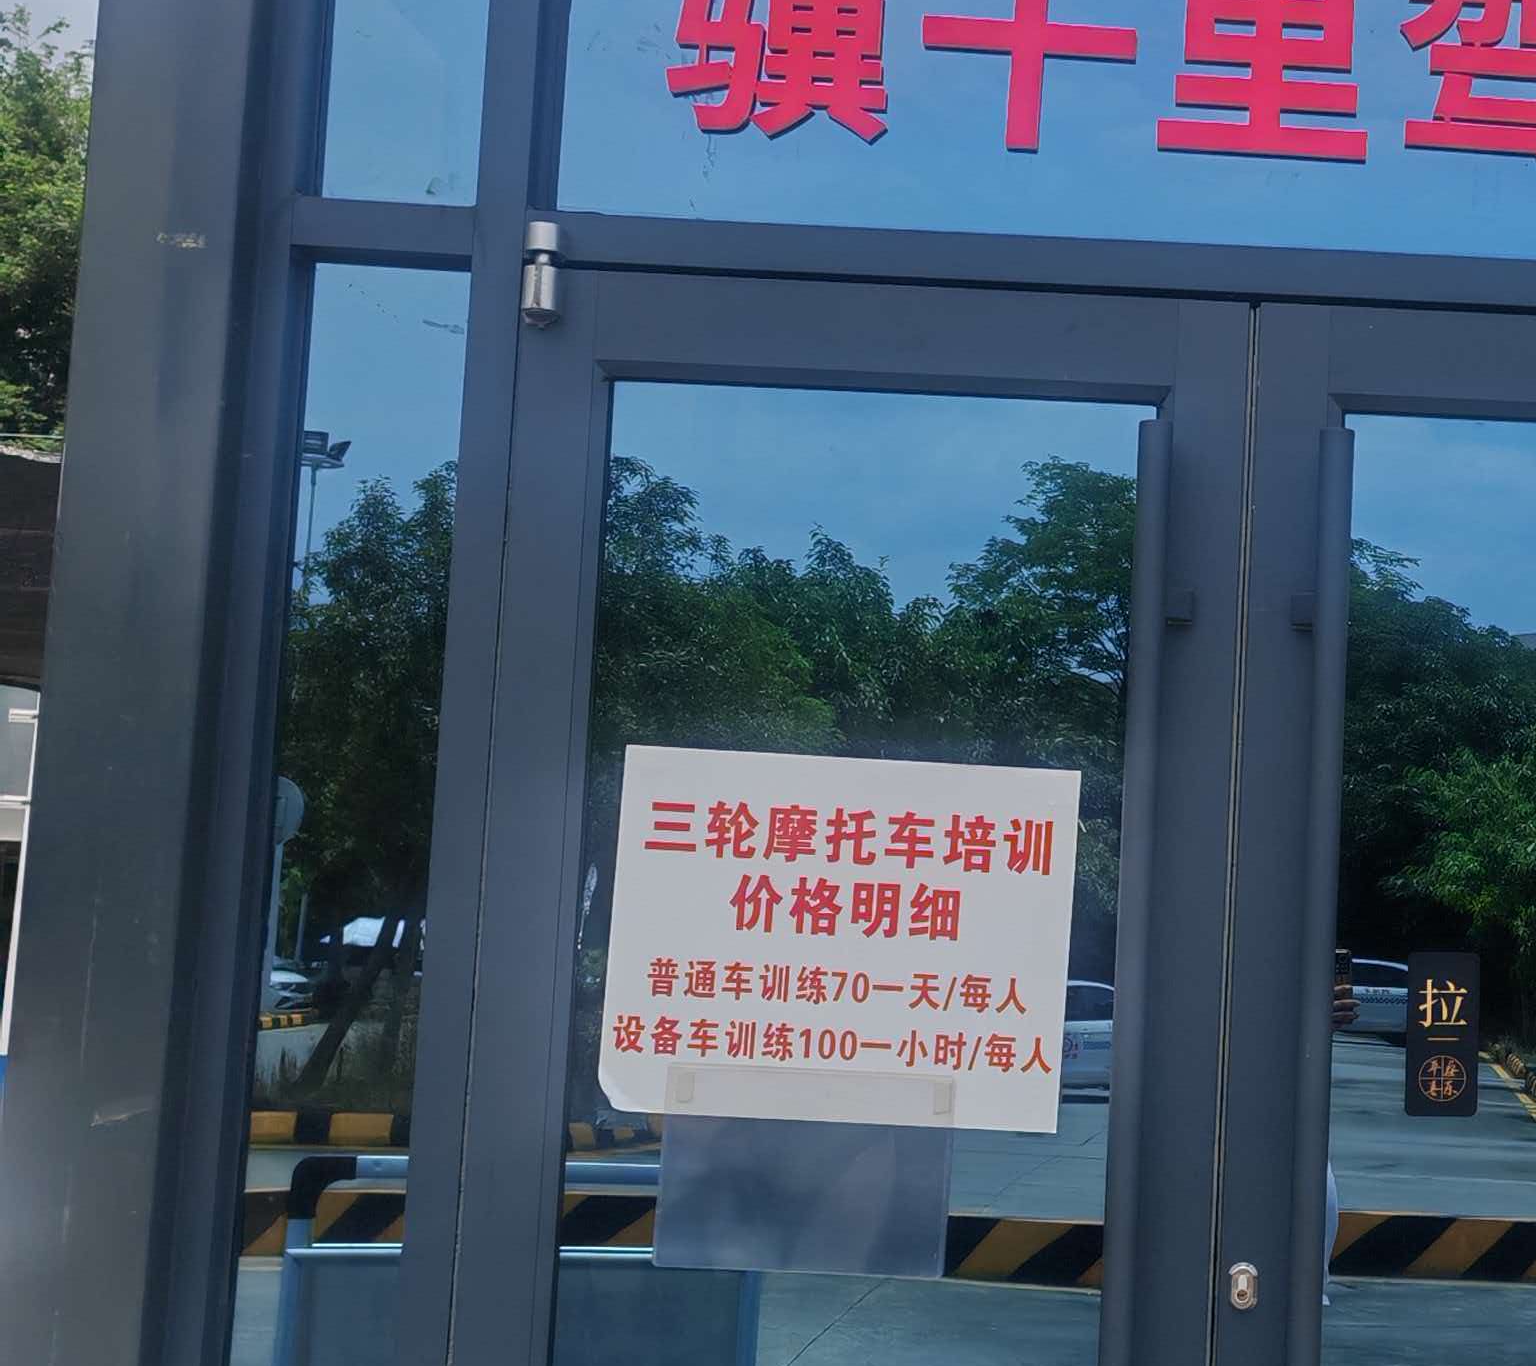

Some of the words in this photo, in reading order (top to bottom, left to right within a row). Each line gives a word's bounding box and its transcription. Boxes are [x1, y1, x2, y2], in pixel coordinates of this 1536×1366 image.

[644, 800, 1054, 875] 三轮摩托车培训
[730, 873, 961, 941] 价格明细
[1418, 979, 1468, 1028] 拉
